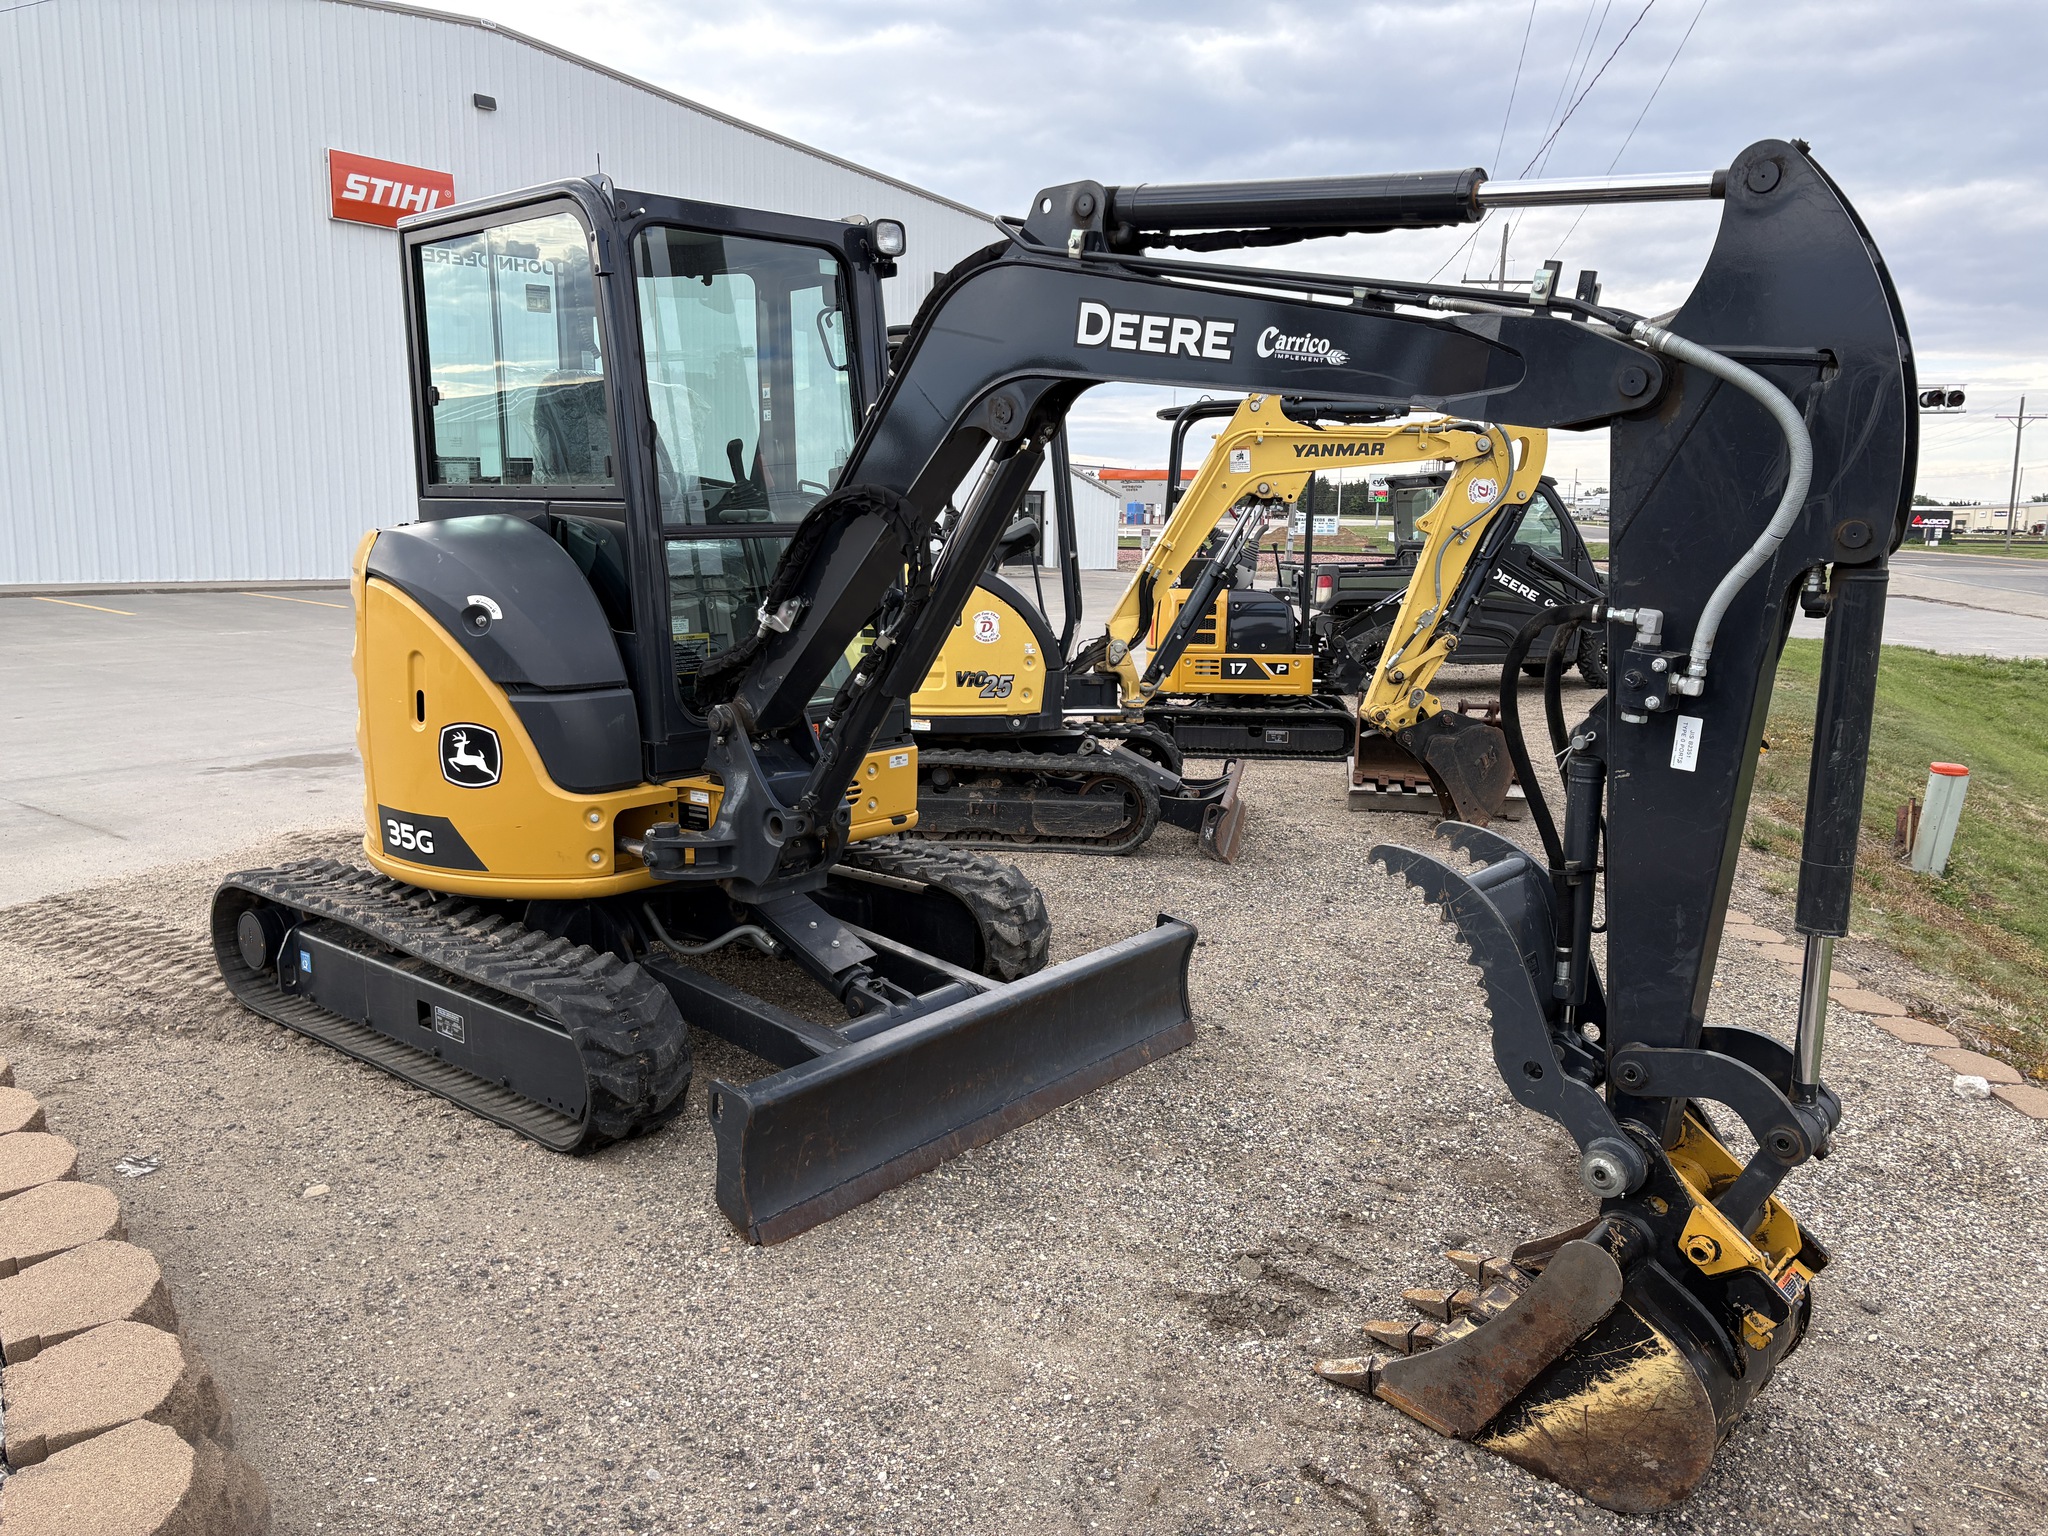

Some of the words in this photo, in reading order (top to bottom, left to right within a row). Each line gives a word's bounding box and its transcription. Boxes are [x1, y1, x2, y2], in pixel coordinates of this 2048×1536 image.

[341, 173, 440, 213] STIHL
[1077, 302, 1235, 360] DEERE
[1257, 326, 1330, 358] Carrico
[1274, 353, 1324, 363] IMPLEMENT
[1293, 443, 1385, 457] YANMAR
[1230, 663, 1247, 674] 17
[1276, 664, 1287, 673] P
[387, 819, 434, 854] 35G
